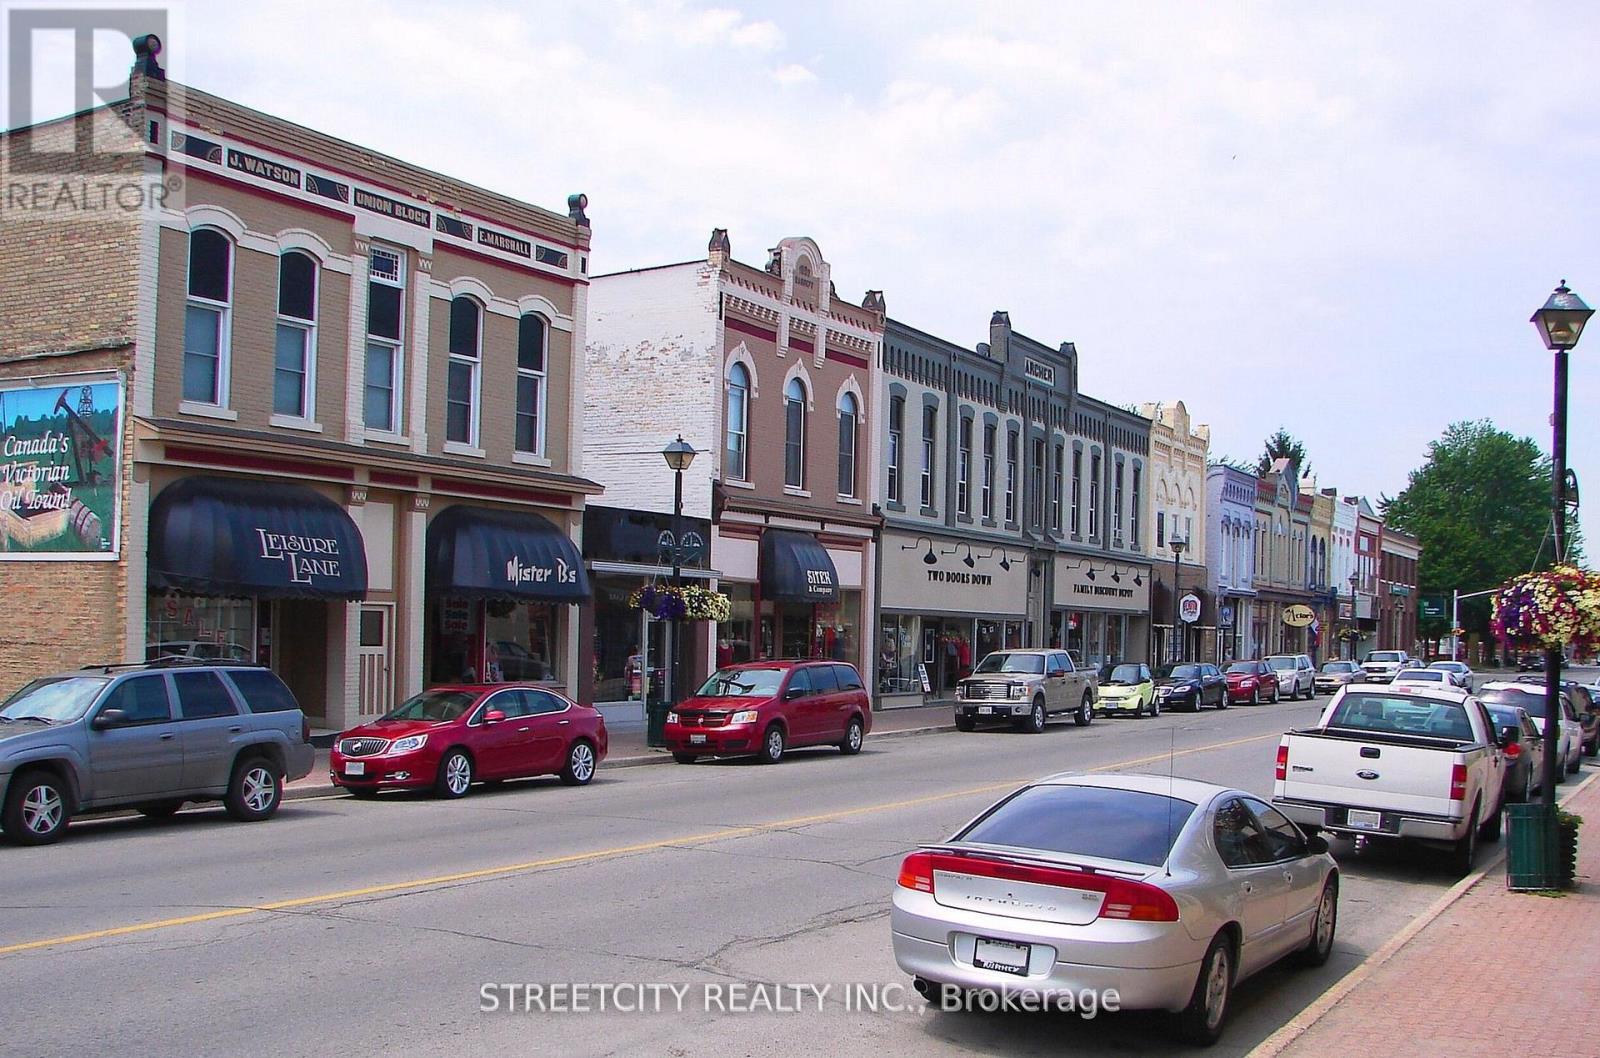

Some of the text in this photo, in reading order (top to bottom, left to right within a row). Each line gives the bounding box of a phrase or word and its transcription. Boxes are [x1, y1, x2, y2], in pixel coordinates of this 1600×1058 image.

[245, 158, 299, 185] WATSON
[356, 191, 429, 225] UNION BLOCK
[1025, 359, 1053, 383] ARCHER
[4, 430, 70, 457] Canada's
[2, 460, 70, 484] Victorian
[0, 487, 72, 510] Oil Town!
[256, 528, 339, 561] LEISURE
[288, 552, 340, 585] LANE
[507, 555, 552, 586] Mister
[927, 569, 992, 586] TWO DOORS DOWN
[1073, 583, 1134, 599] FAMILY DISCOUNT DEPOT
